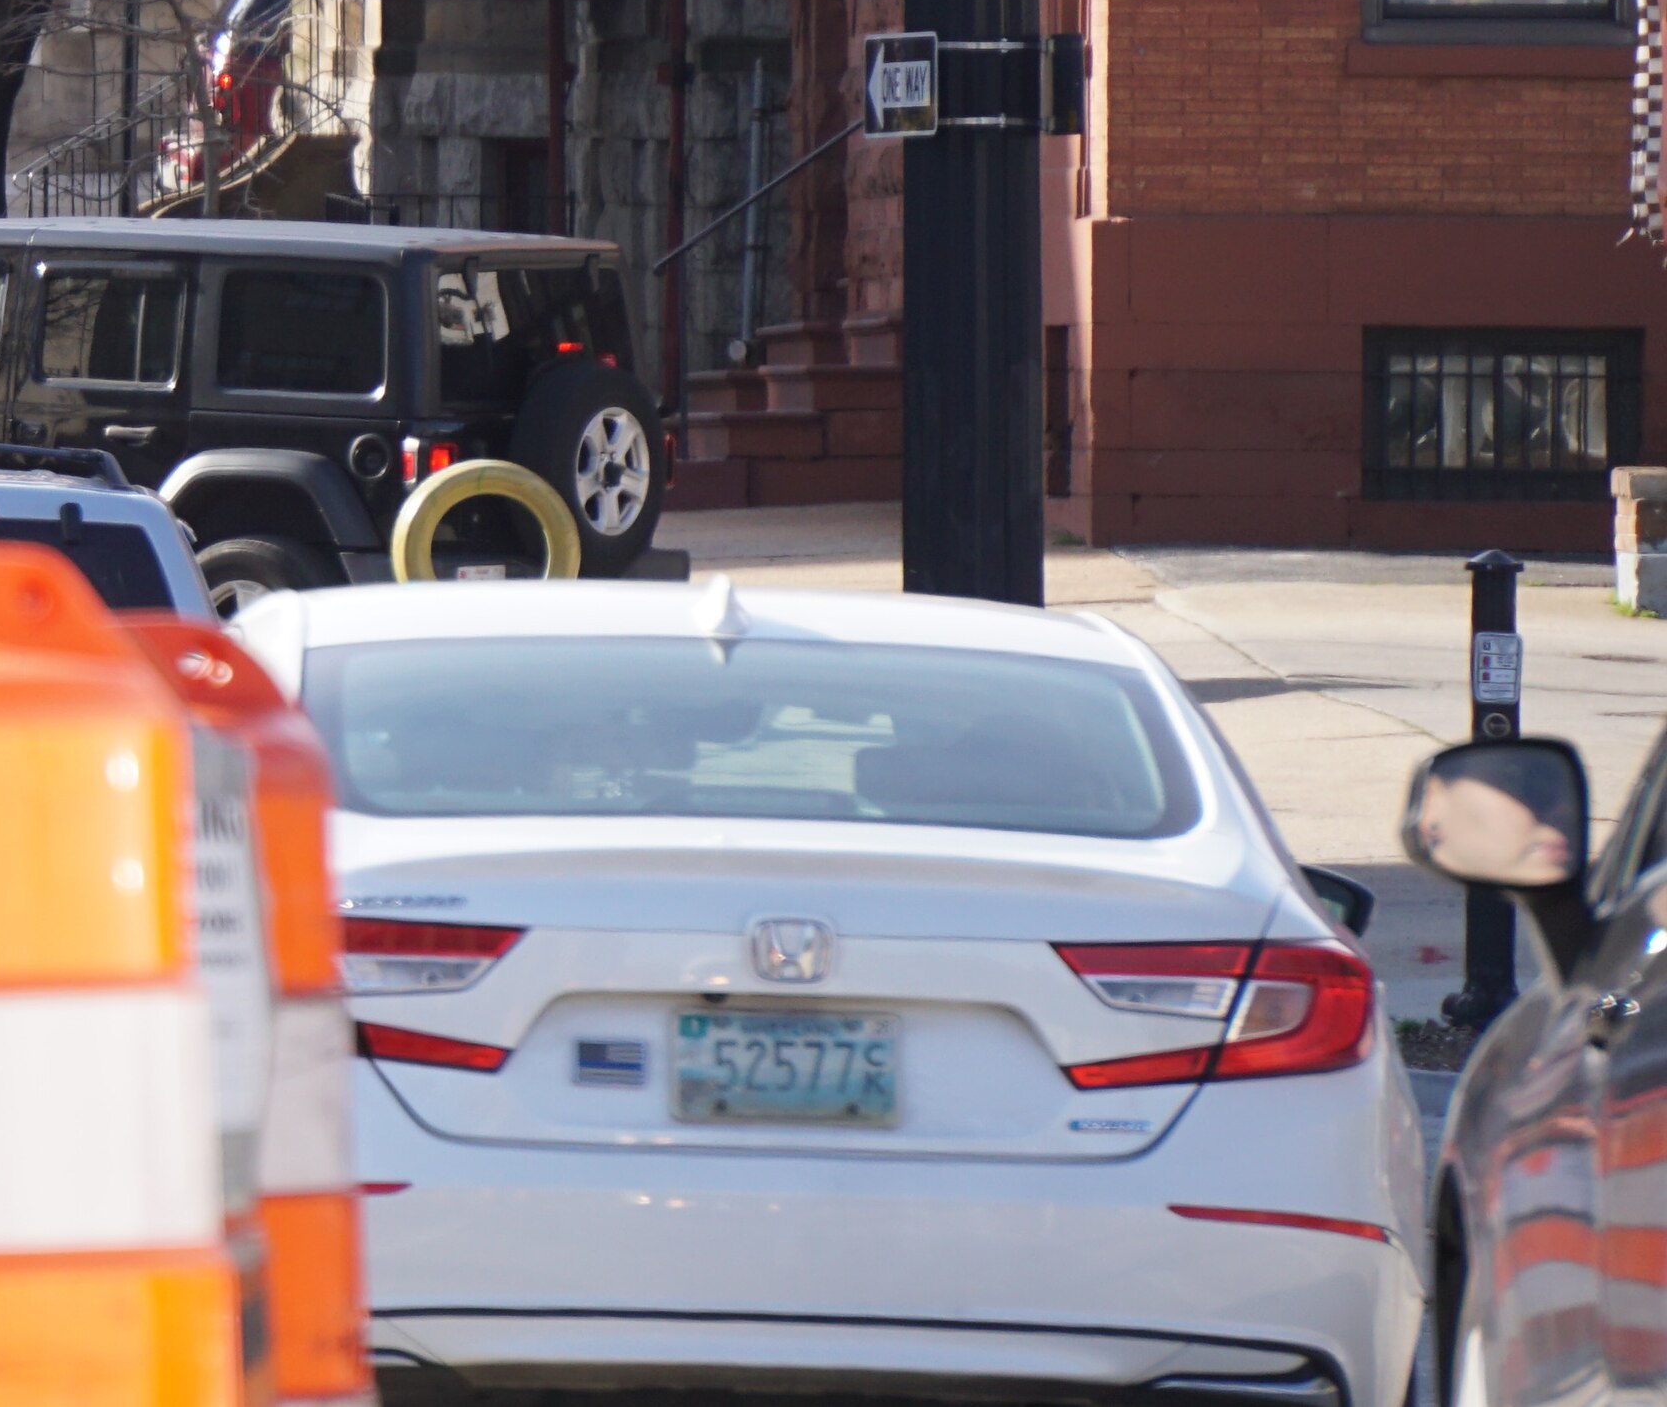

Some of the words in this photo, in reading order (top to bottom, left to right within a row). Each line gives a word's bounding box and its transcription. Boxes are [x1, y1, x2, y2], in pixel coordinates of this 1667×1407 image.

[882, 67, 901, 104] ONE
[906, 65, 927, 103] WAY
[714, 1040, 856, 1092] 52577
